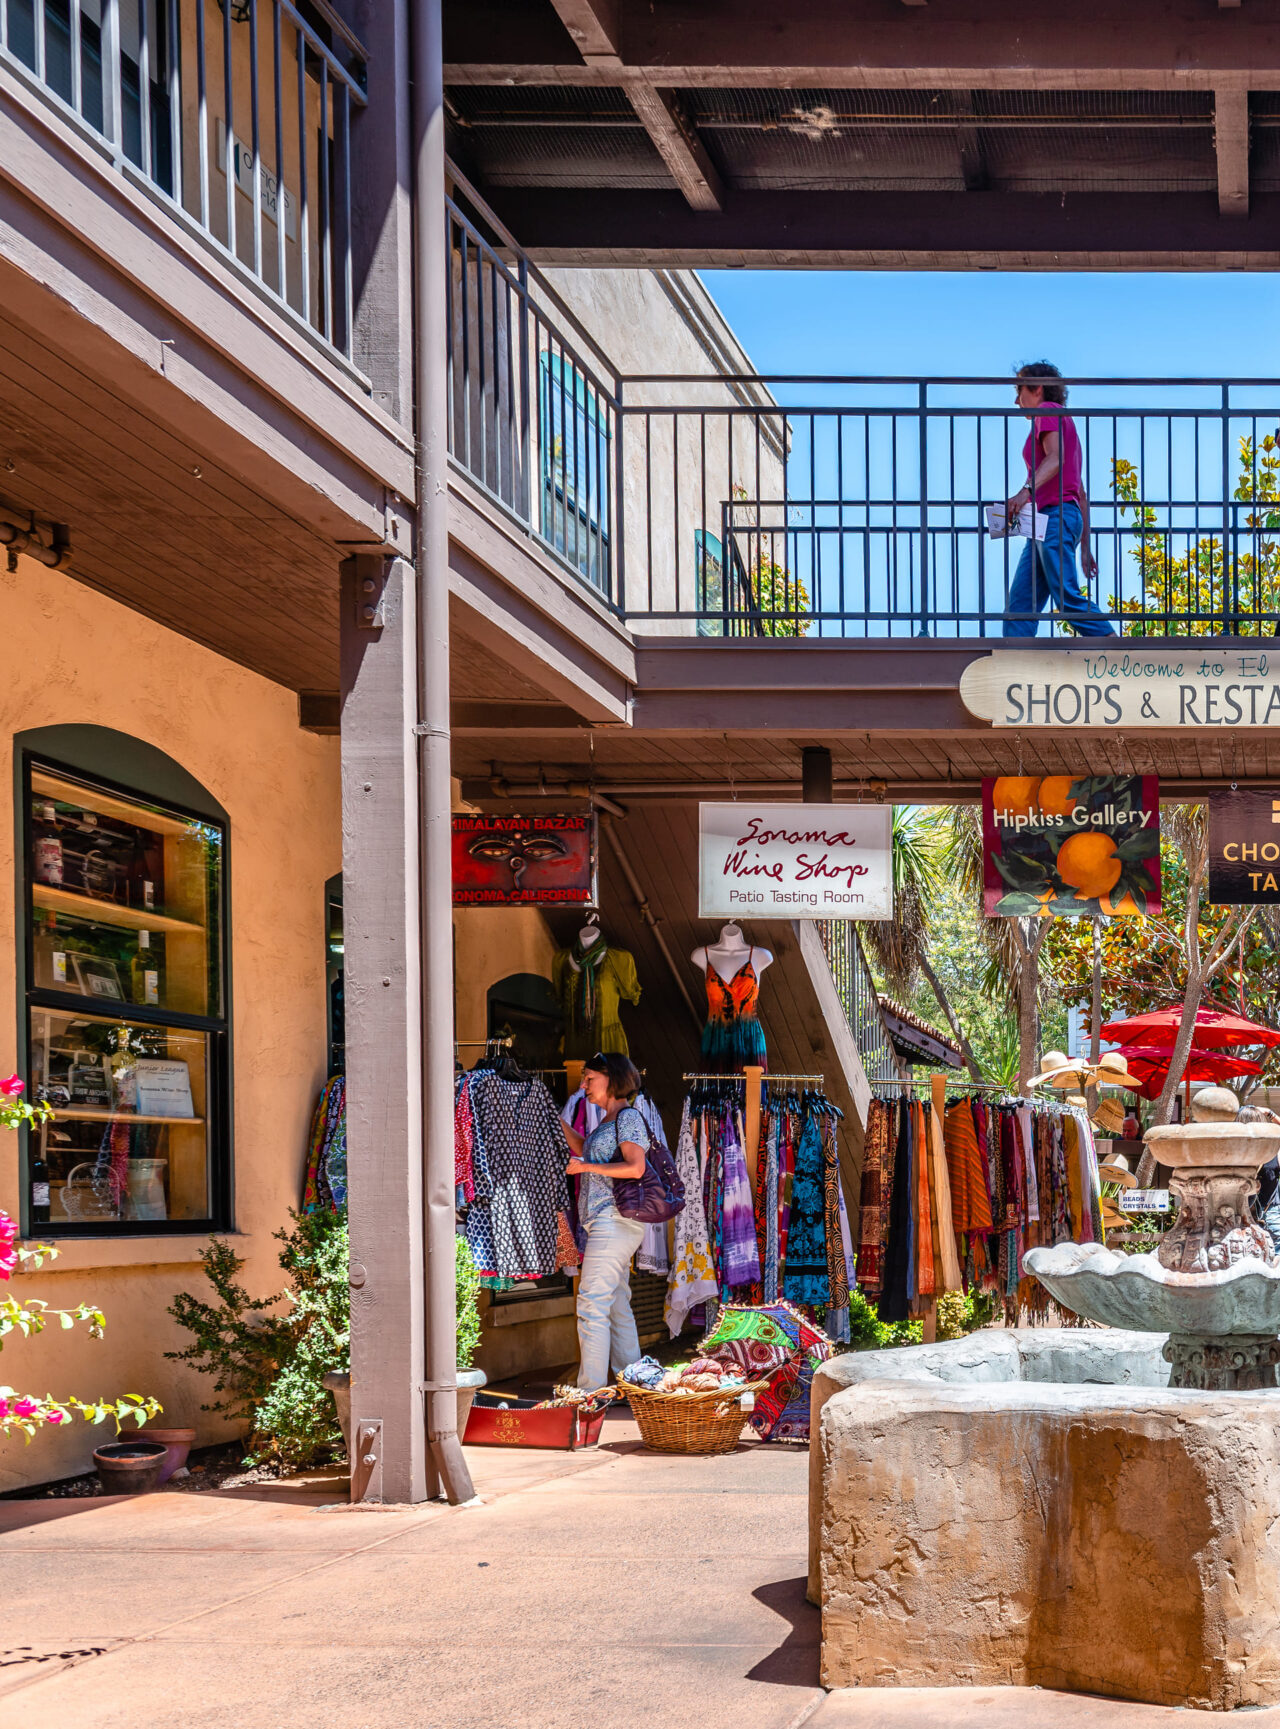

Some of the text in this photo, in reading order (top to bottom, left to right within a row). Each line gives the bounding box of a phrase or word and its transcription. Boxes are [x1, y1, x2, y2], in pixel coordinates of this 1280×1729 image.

[1084, 655, 1185, 679] Welcome
[1197, 659, 1225, 677] to
[1237, 655, 1269, 677] El
[1006, 683, 1122, 725] SHOPS
[1141, 691, 1160, 719] &
[534, 817, 585, 830] BAZAR
[736, 817, 856, 847] Sonoma
[993, 804, 1153, 833] Hipkiss Gallery
[723, 850, 869, 889] Wine Shop
[729, 890, 864, 906] Patio Tasting Room
